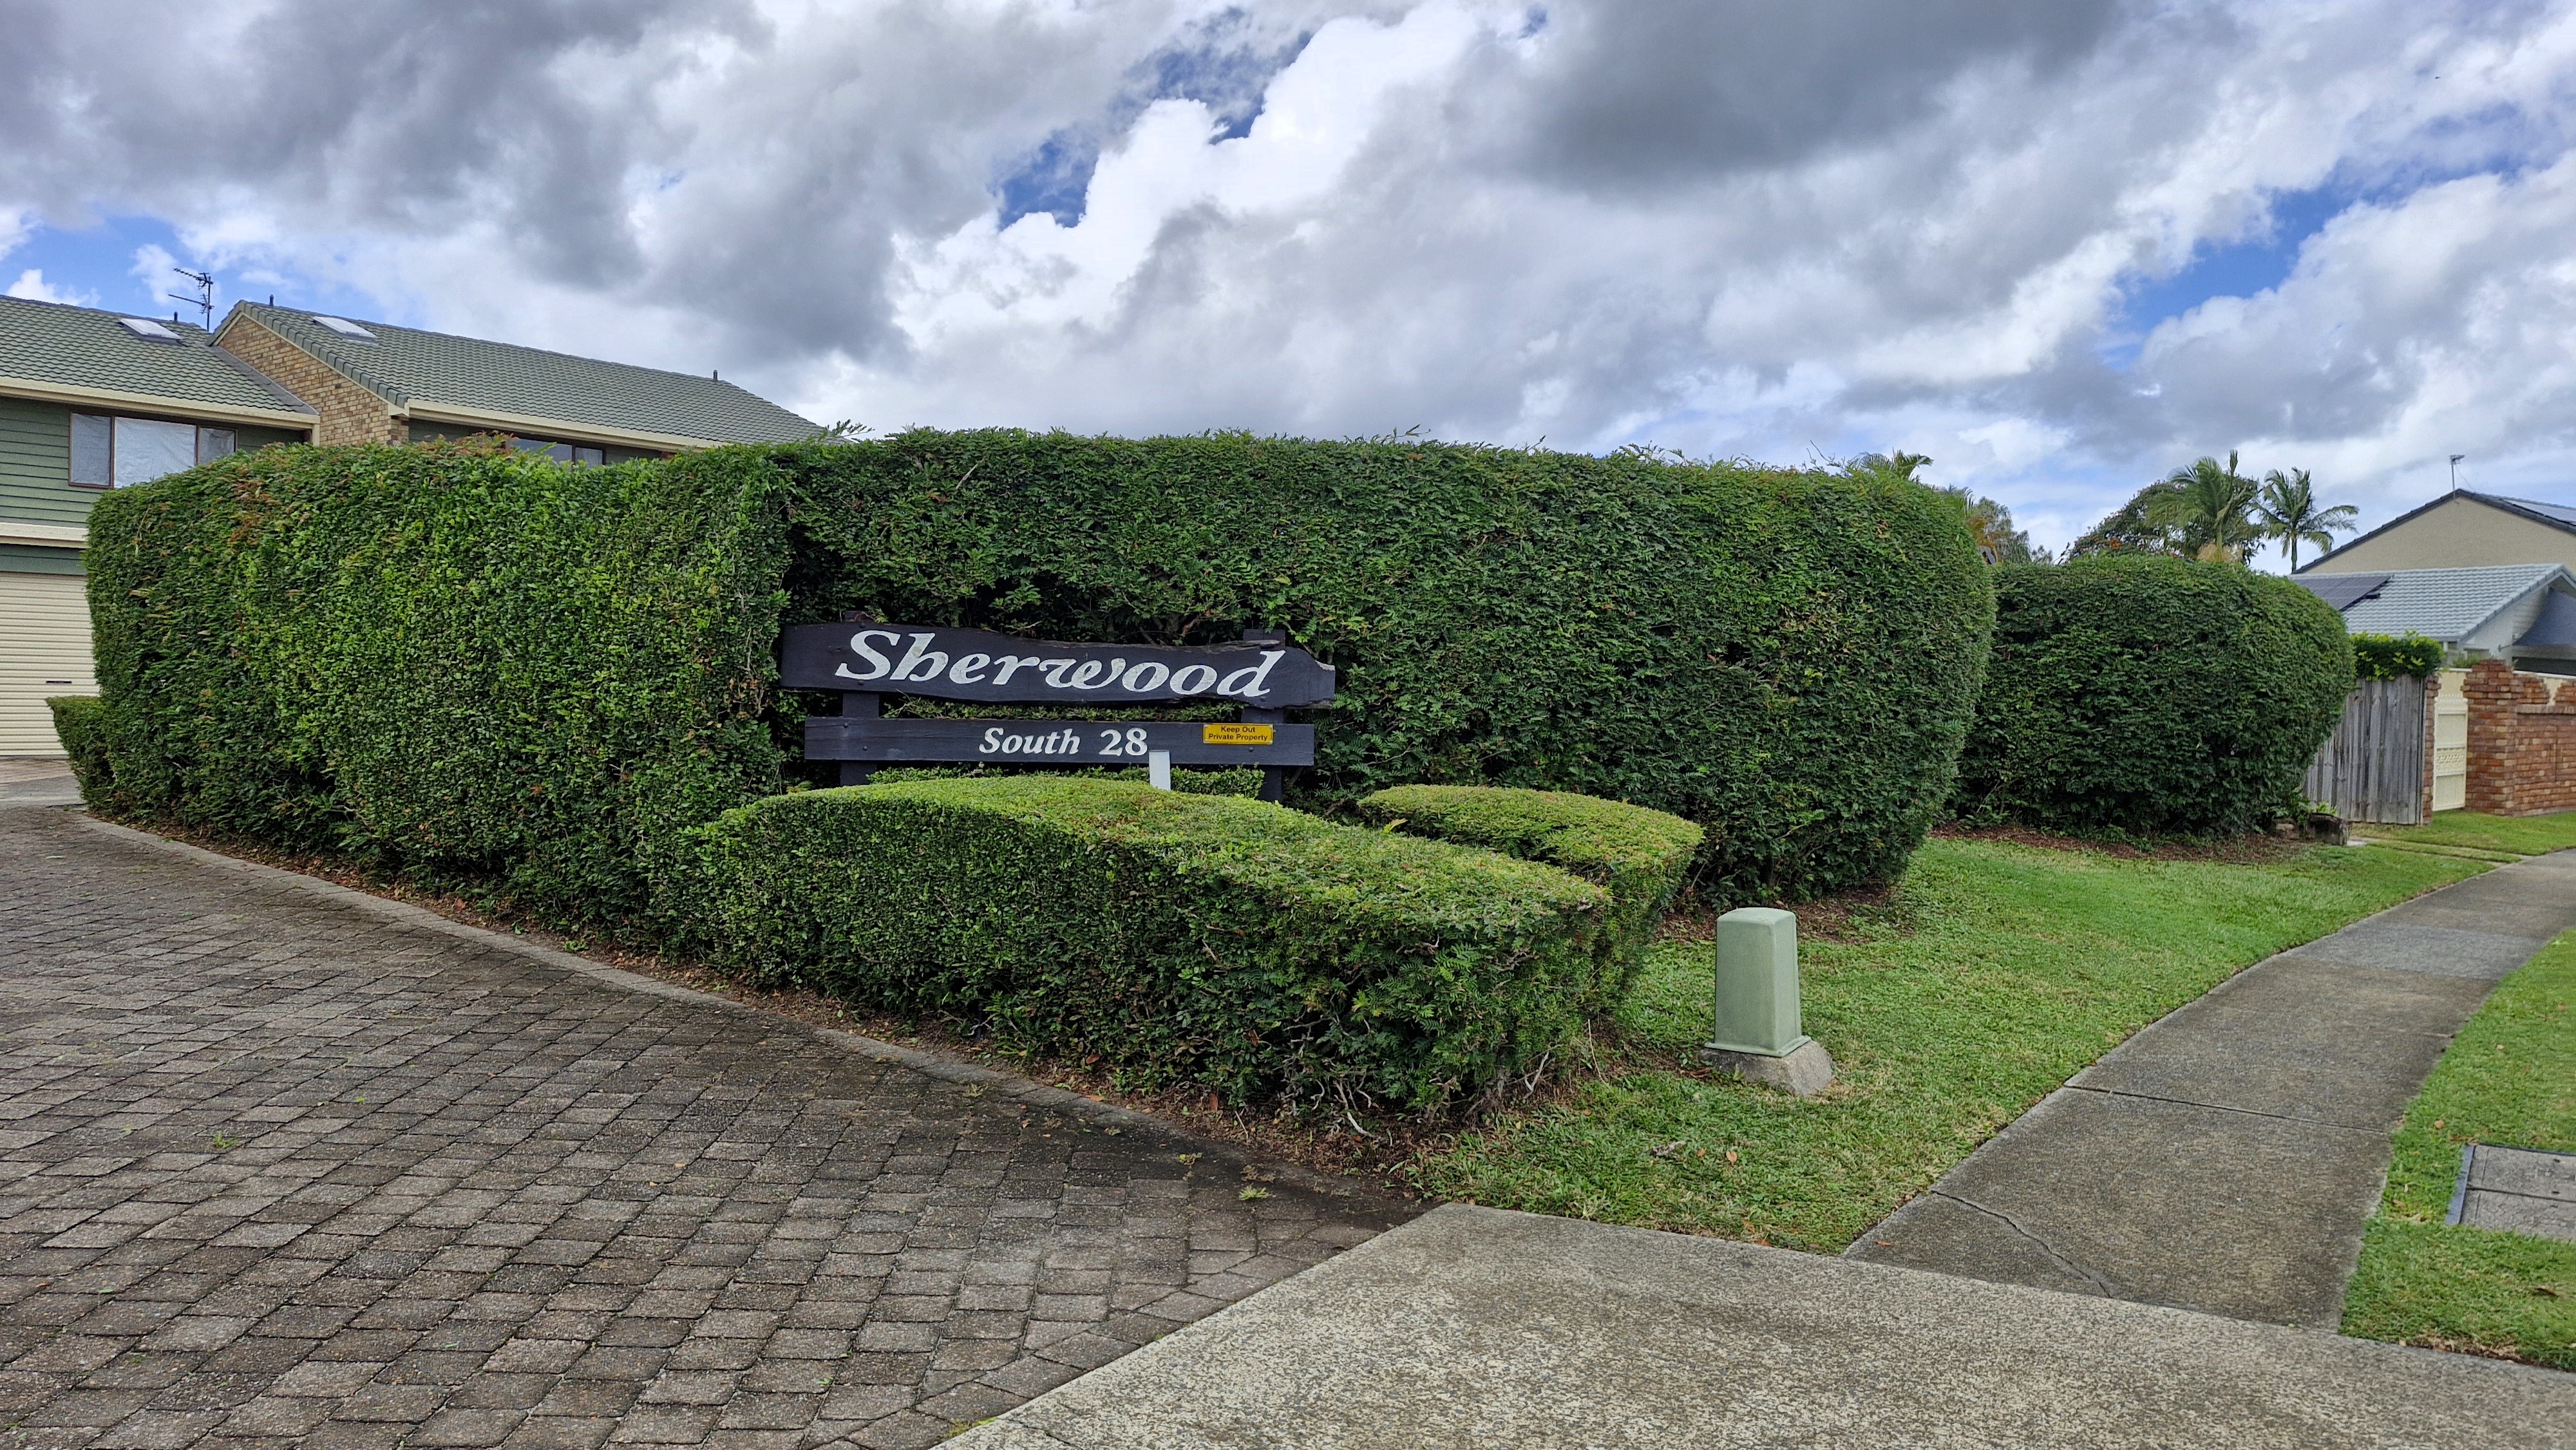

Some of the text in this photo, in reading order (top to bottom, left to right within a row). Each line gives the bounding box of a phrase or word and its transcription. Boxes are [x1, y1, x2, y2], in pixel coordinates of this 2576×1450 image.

[835, 630, 1286, 697] Sherwood
[979, 727, 1148, 757] South 28
